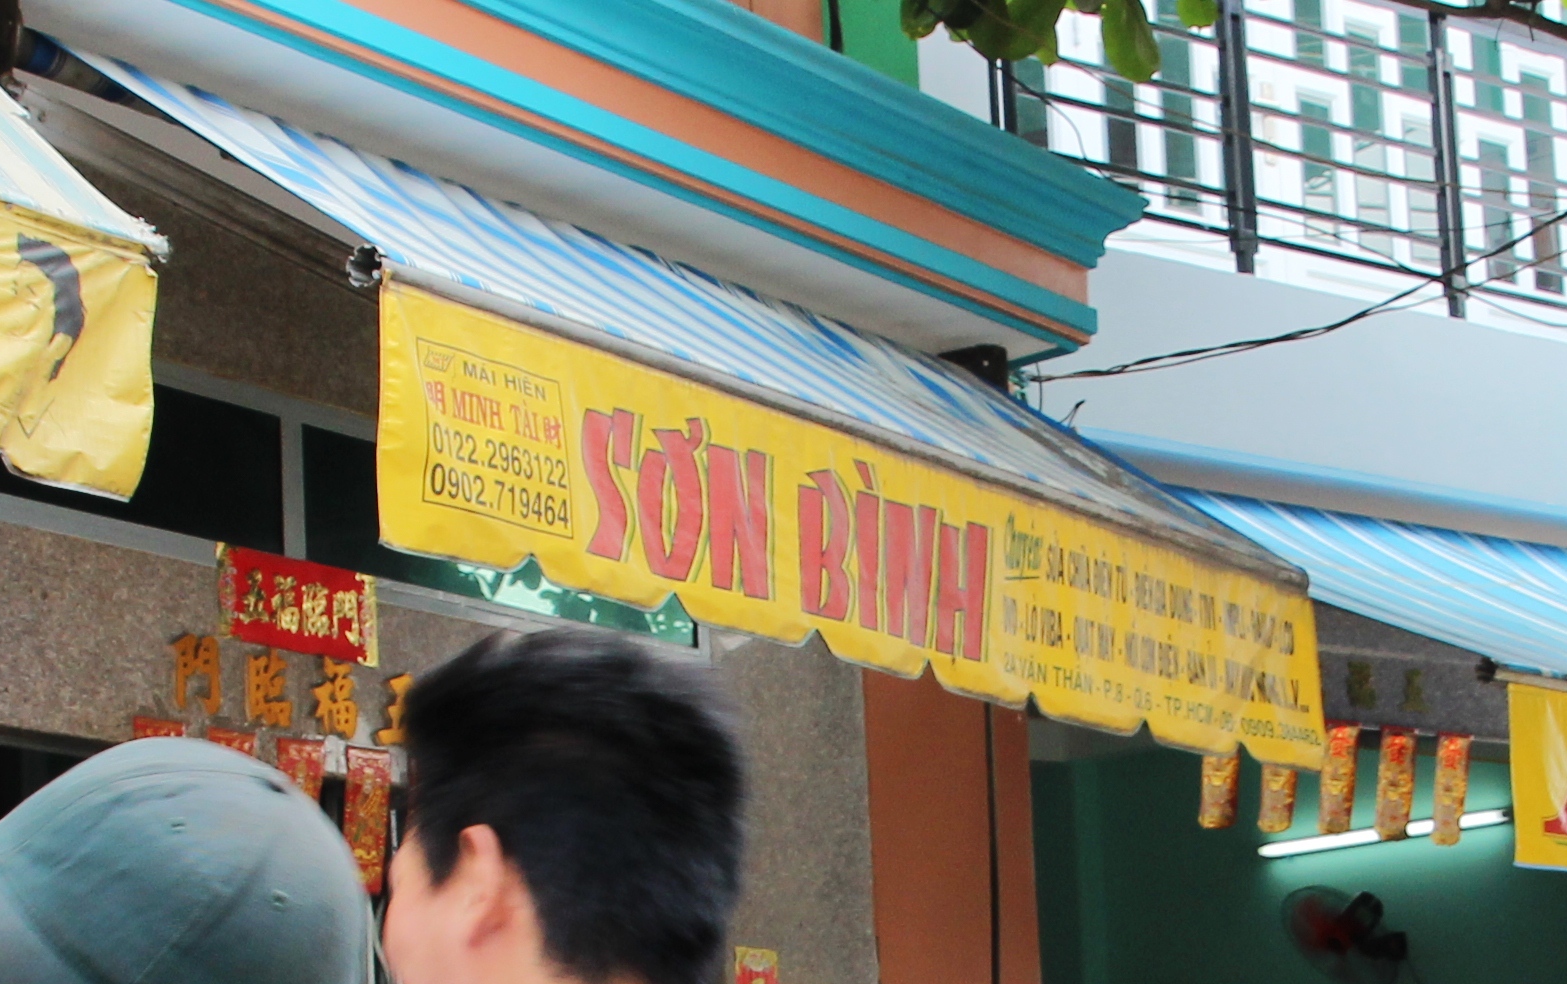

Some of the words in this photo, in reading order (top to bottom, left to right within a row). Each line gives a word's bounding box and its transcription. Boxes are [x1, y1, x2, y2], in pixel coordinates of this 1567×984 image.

[451, 388, 505, 431] MINH
[510, 399, 541, 442] TÀI
[432, 422, 569, 489] 0122.2963122
[430, 462, 570, 530] 0902.719464
[581, 406, 773, 601] SƠN
[797, 458, 992, 662] BÌNH
